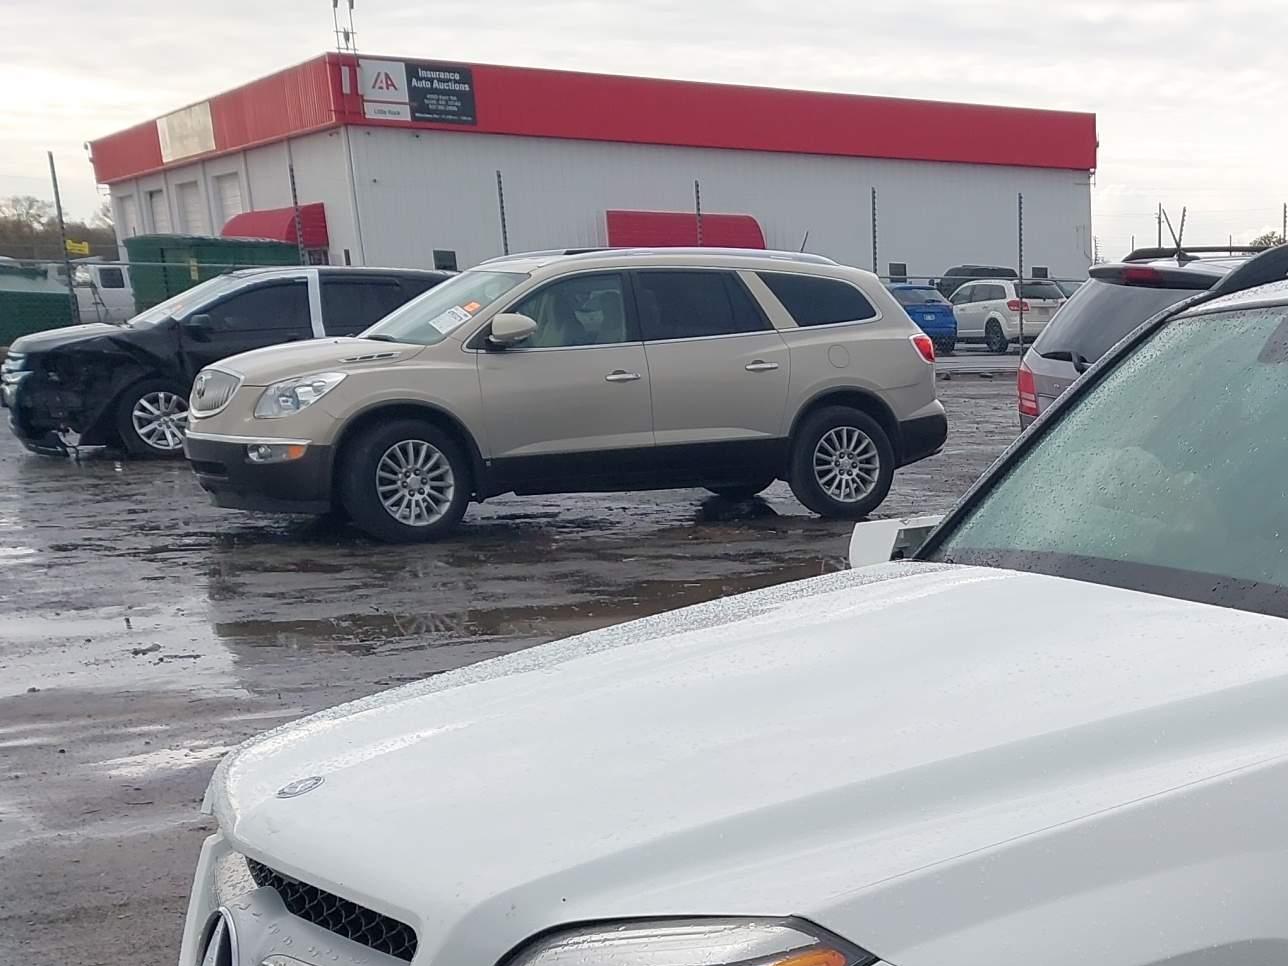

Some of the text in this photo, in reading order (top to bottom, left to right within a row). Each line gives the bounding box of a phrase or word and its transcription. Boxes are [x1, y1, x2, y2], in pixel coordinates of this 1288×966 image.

[418, 68, 460, 80] Insurance
[411, 78, 470, 91] Auto Auctions
